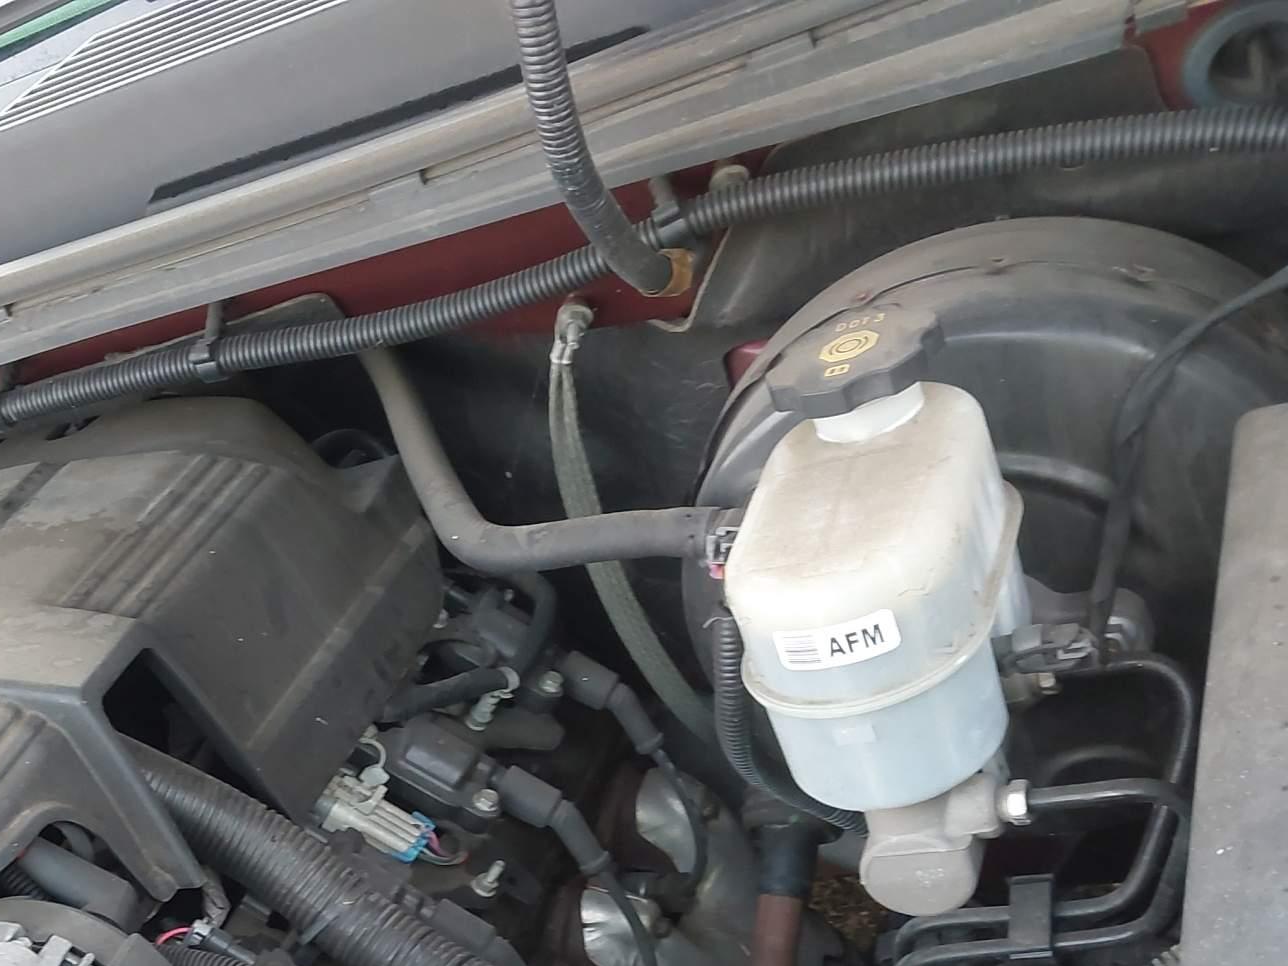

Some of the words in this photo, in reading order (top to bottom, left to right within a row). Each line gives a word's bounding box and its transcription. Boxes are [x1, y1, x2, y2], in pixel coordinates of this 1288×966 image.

[836, 317, 869, 331] DOT
[875, 313, 886, 322] 3
[830, 624, 884, 656] AFM
